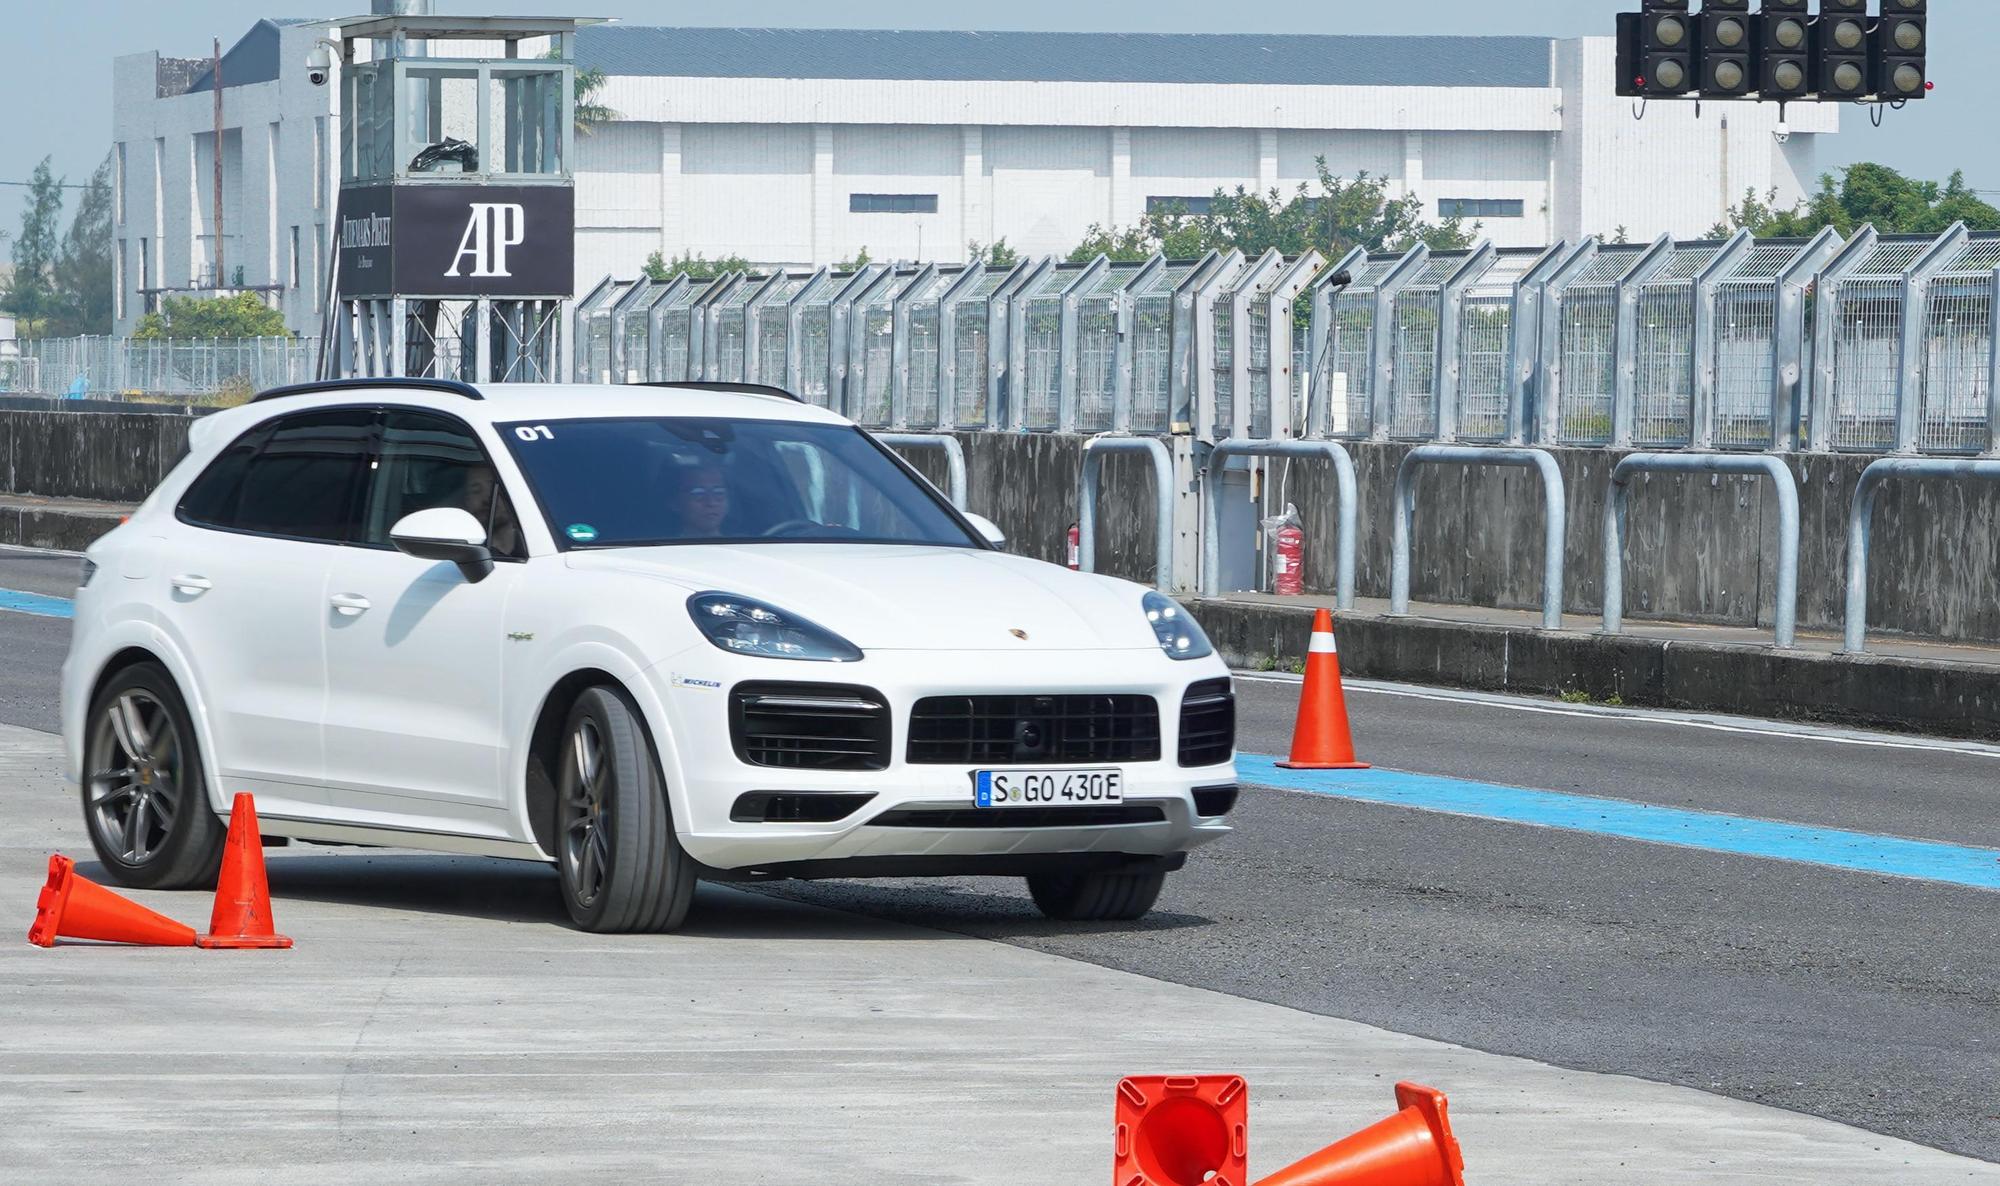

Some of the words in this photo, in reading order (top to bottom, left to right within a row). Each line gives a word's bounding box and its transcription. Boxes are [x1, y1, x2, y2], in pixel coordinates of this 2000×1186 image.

[443, 203, 525, 277] AP
[514, 424, 555, 442] 01
[684, 678, 722, 688] MICHELIN
[981, 792, 988, 801] D
[994, 775, 1008, 802] S
[1024, 775, 1055, 802] GO
[1061, 774, 1120, 801] 430E
